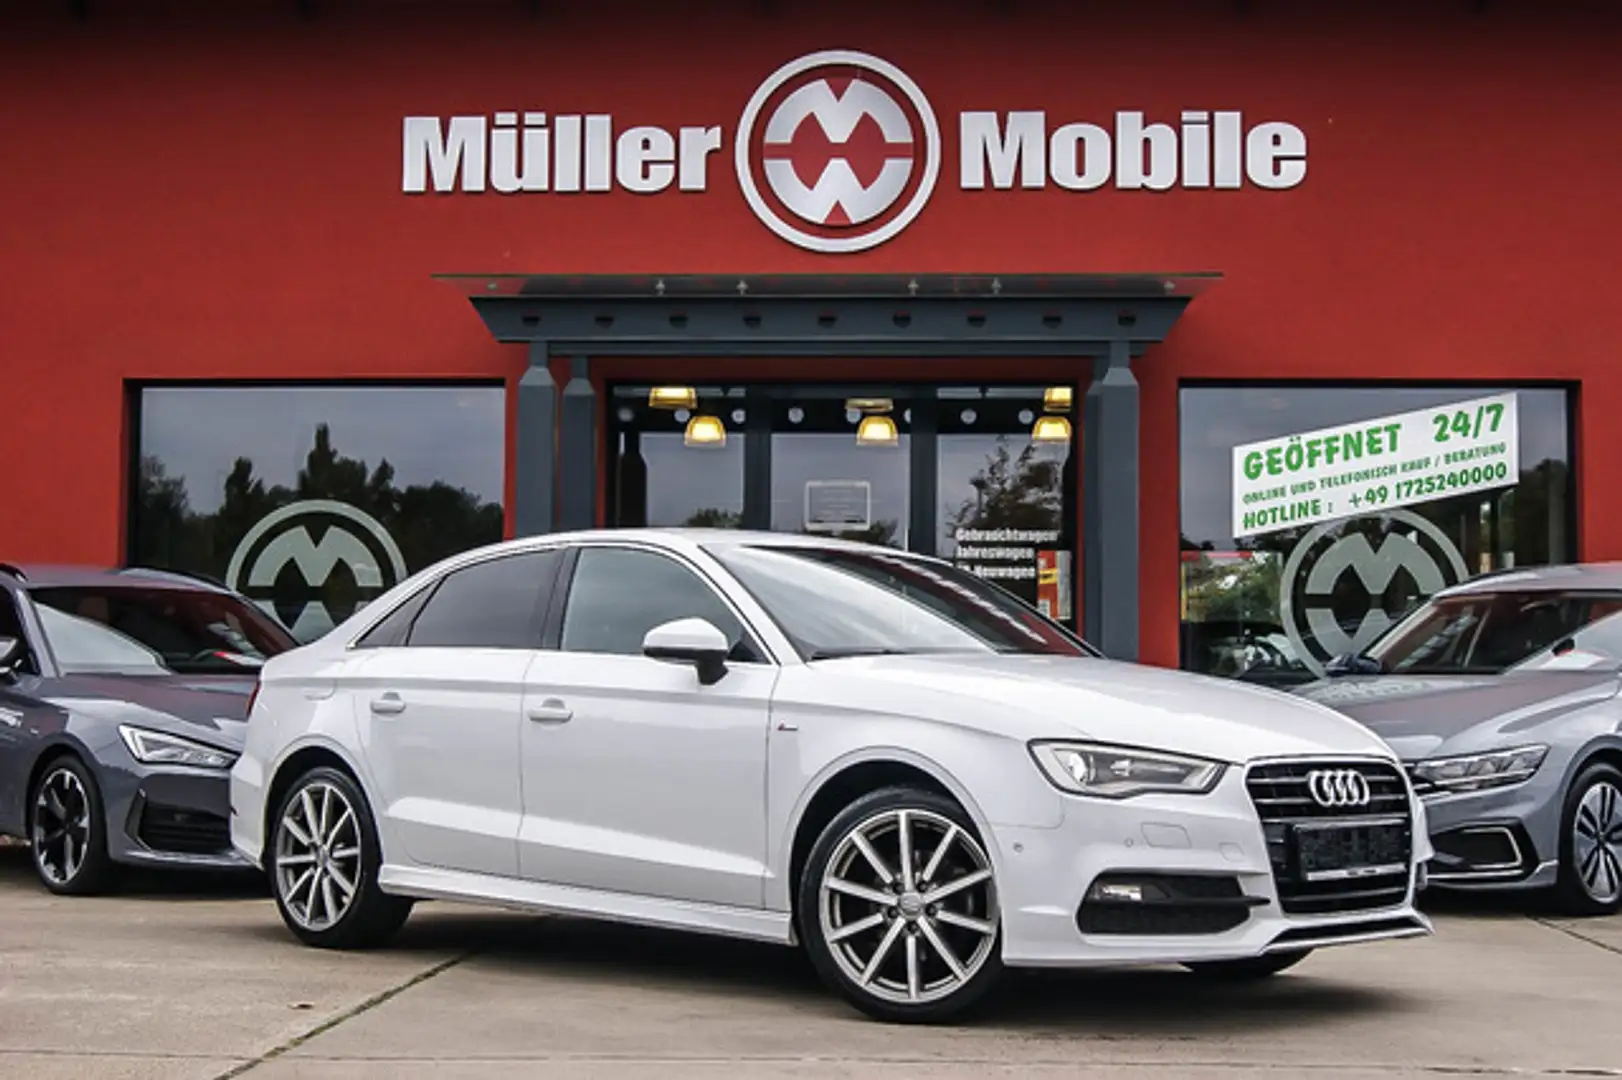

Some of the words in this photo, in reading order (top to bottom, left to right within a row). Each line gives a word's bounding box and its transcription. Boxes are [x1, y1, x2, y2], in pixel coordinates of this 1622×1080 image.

[403, 111, 722, 193] Müller
[960, 110, 1308, 190] Mobile
[1243, 423, 1401, 480] GEÖFFNET
[1432, 402, 1505, 442] 24/7
[1243, 485, 1286, 505] ONLINE
[1290, 480, 1317, 496] UND
[1320, 463, 1397, 489] TELEFONISCH
[1401, 456, 1431, 473] KAUF
[1444, 441, 1506, 464] BERATUNG
[1243, 499, 1322, 530] HOTLINE
[1349, 484, 1389, 508] +49
[1395, 461, 1507, 500] 1725240000
